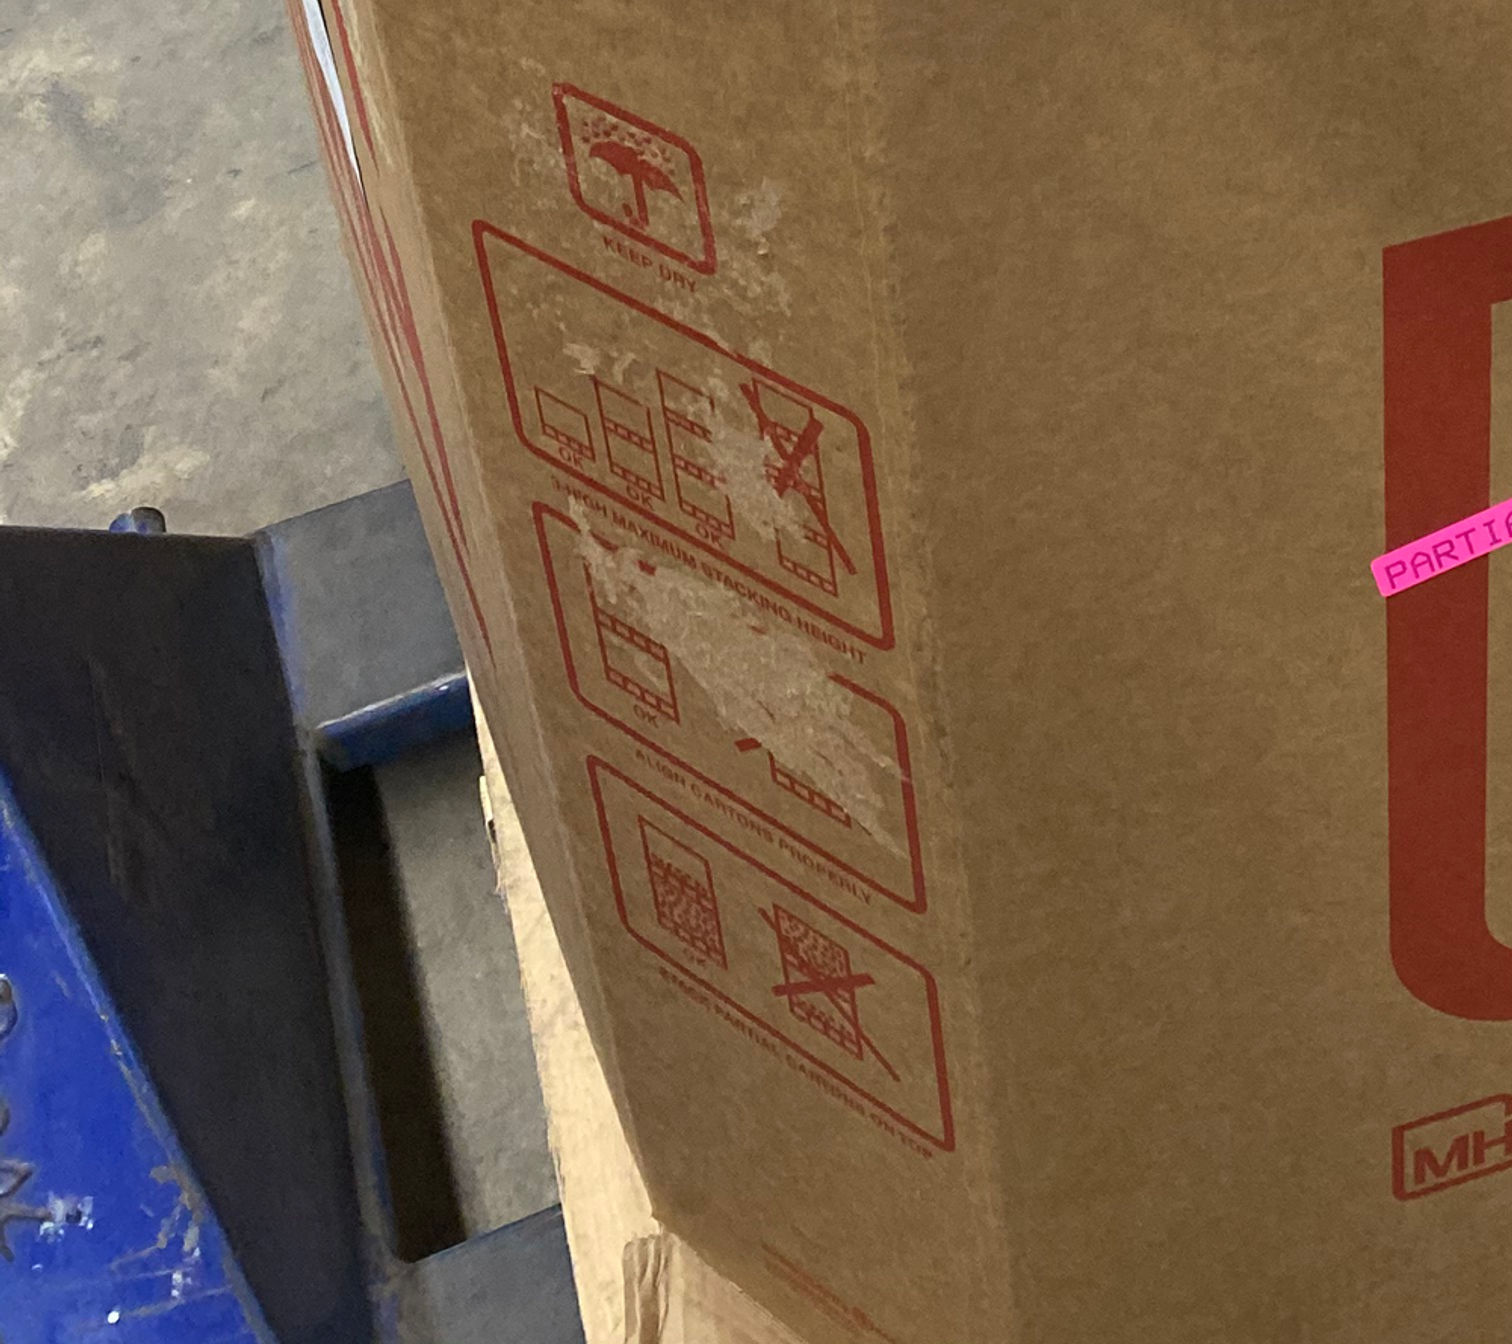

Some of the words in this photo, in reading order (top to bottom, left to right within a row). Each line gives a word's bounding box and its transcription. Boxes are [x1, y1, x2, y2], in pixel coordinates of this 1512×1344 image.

[603, 236, 653, 269] KEEP
[659, 264, 697, 294] DRY
[559, 446, 585, 469] OK
[626, 484, 654, 511] OK
[695, 523, 724, 549] OK
[611, 512, 697, 568] MAXIMUM
[702, 565, 793, 623] STACKING
[797, 614, 868, 665] HEIGHT
[633, 703, 660, 729] OK
[635, 748, 687, 792] ALIGN
[690, 780, 775, 844] CARTONS
[779, 836, 873, 907] PROPERLY
